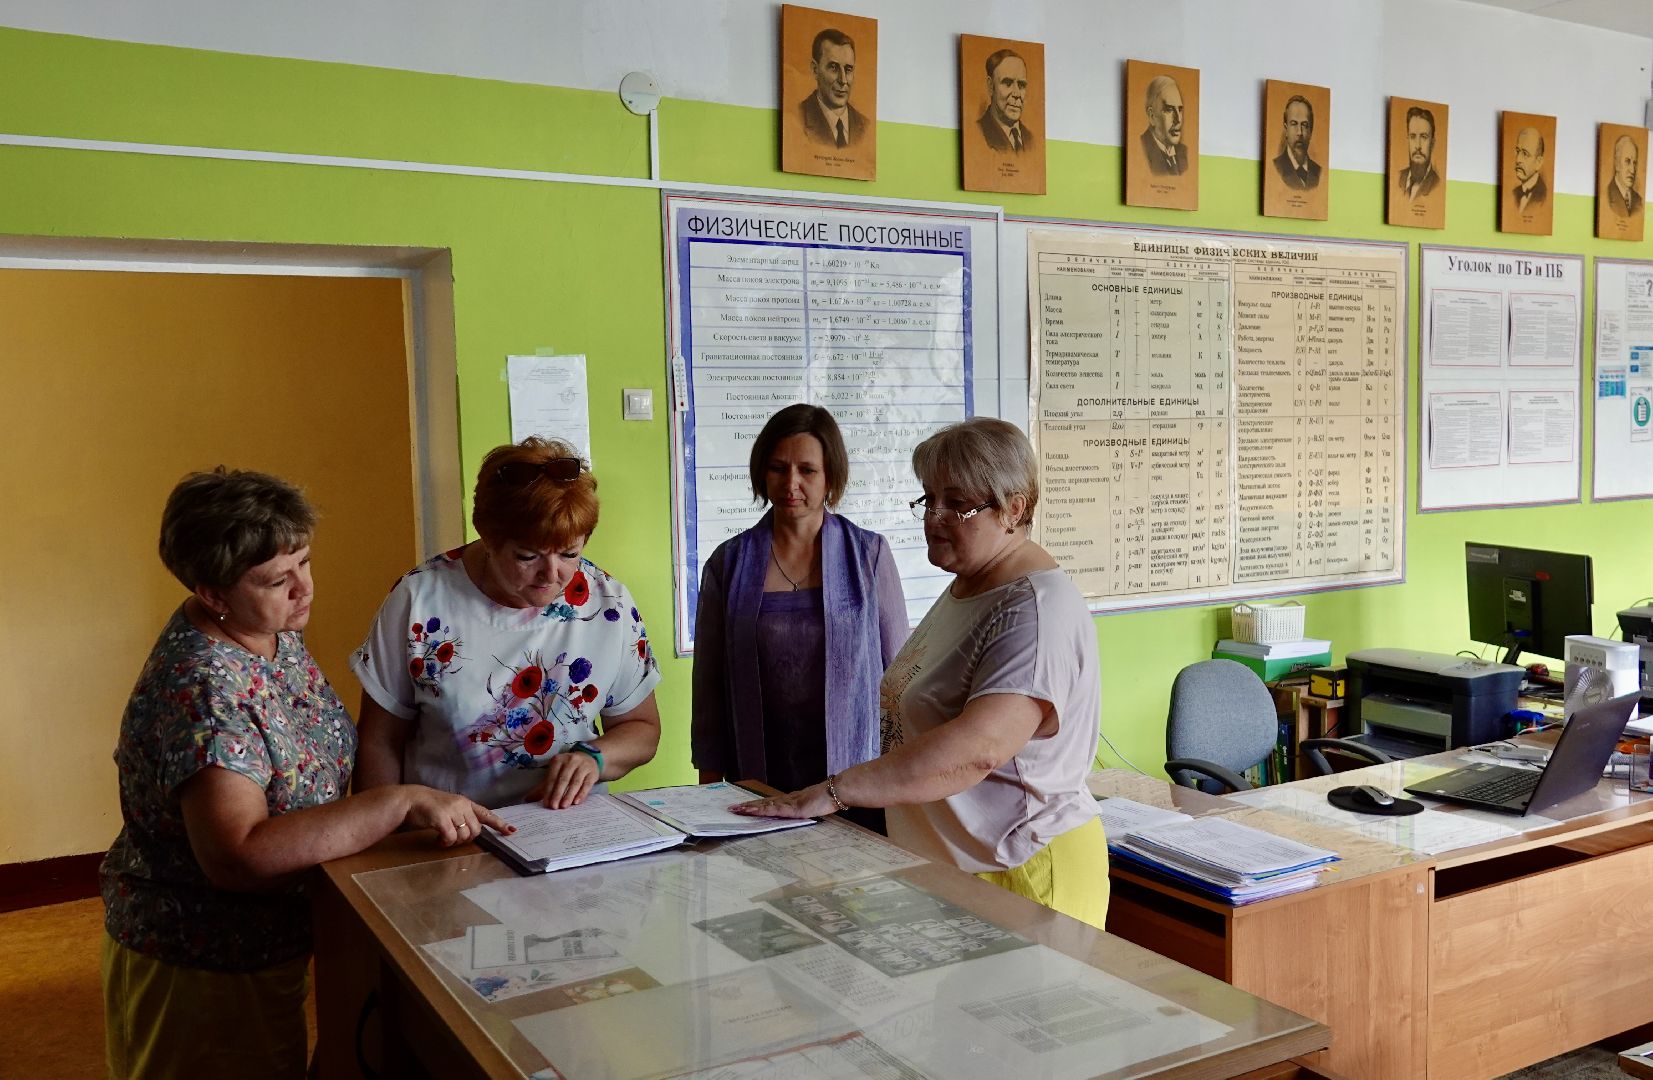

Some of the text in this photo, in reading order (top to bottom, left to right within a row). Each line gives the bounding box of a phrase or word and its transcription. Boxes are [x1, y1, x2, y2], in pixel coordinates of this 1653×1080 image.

[687, 215, 965, 250] ФИЗИЧЕСКИЕ ПОСТОЯННЫЕ
[1133, 242, 1190, 255] ЕДИНИЦЫ
[1193, 246, 1267, 259] ФИЗИЧЕСКИХ
[1270, 251, 1319, 262] ВЕЛИЧИН
[1448, 254, 1563, 279] Уголок по ТБ и ПБ
[1091, 283, 1183, 295] ОСНОВНЫЕ ЕДИНИЦЫ
[1271, 291, 1363, 302] ПРОИЗВОДНЫЕ ЕДИНИЦЫ
[1076, 398, 1200, 407] ДОПОЛНИТЕЛЬНЫЕ ЕДИНИЦЫ
[1083, 437, 1190, 447] ПРОИЗВОДНЫЕ ЕДИНИЦЫ
